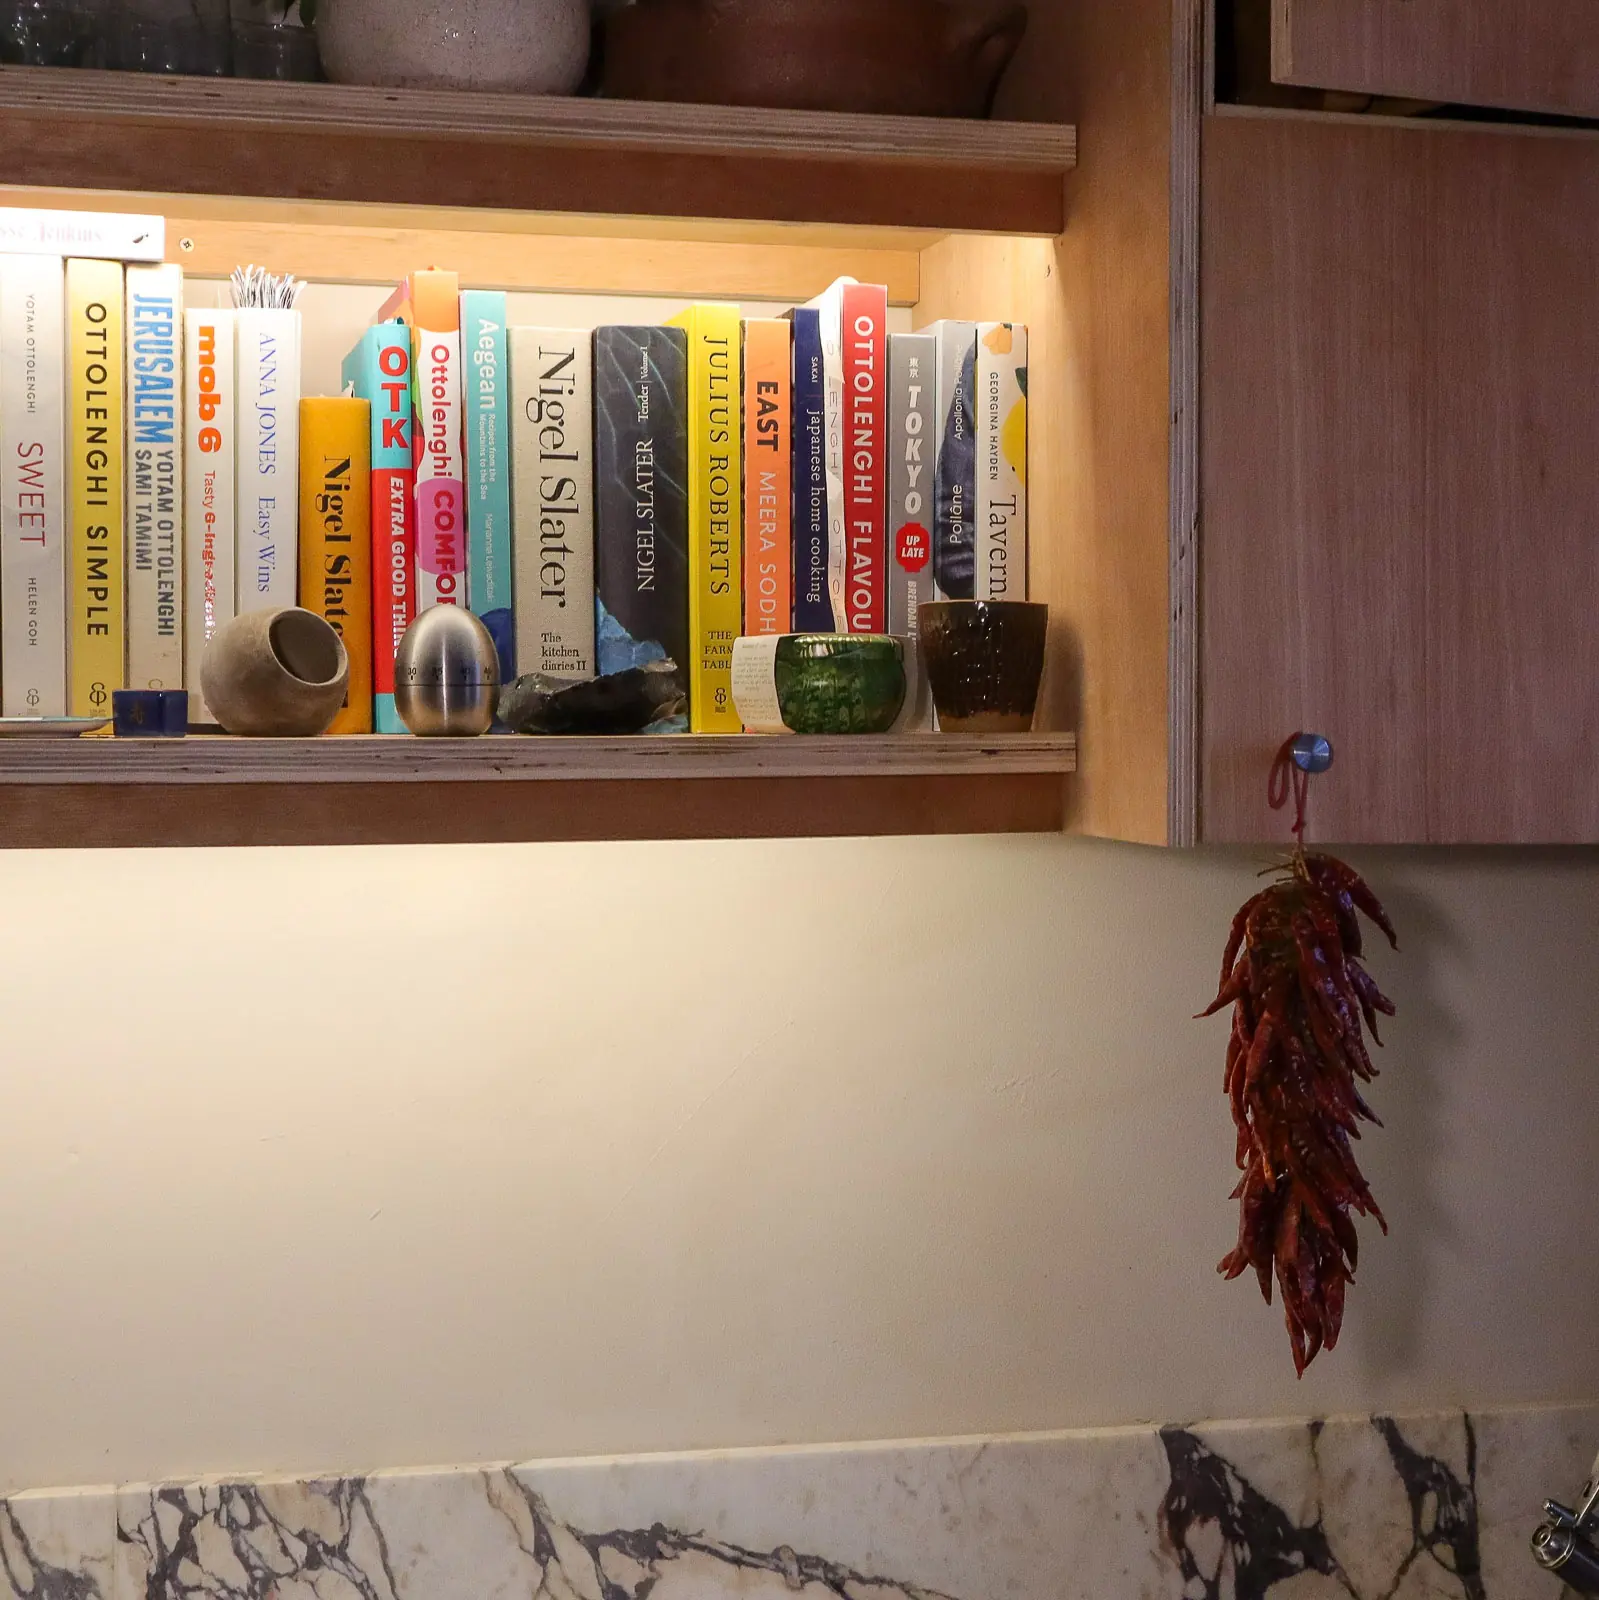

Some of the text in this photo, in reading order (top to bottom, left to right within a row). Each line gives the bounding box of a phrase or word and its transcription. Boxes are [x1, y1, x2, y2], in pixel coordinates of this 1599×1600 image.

[26, 293, 37, 414] YOTAM OTTOLENGHI
[133, 293, 174, 444] JERUSALEM
[198, 326, 222, 453] mob 6
[379, 345, 409, 449] OTK
[473, 318, 500, 410] Aegean
[640, 350, 649, 380] Volume
[811, 356, 819, 383] SAKAI
[908, 356, 919, 379] 東京
[428, 344, 453, 477] Ottolenghi
[637, 384, 649, 423] Tender
[756, 381, 779, 452] EAST
[953, 387, 963, 441] Apollonia
[989, 371, 999, 481] GEORGINA HAYDEN
[85, 302, 109, 636] OTTOLENGHI SIMPLE
[134, 449, 153, 497] SAMI
[203, 470, 216, 509] Tasty
[252, 332, 277, 593] ANNA JONES Easy Wins
[478, 413, 489, 500] Mountains to the Sea
[487, 413, 497, 482] Recipes from the
[526, 345, 580, 609] Nigel Slater
[635, 438, 654, 519] SLATER
[703, 335, 730, 596] JULIUS ROBERTS
[852, 315, 875, 630] OTTOLENGHI FLAVOU
[904, 385, 923, 515] TOKYO
[17, 442, 46, 548] SWEET
[806, 408, 826, 603] japanese home cooking
[949, 484, 963, 544] Poilâne
[157, 450, 175, 636] YOTAM OTTOLENGHI
[315, 455, 352, 637] Nigel Slat
[390, 475, 407, 658] EXTRA GOOD THIN
[433, 490, 457, 607] COMFO
[636, 523, 655, 592] NIGEL
[759, 471, 777, 633] MEERA SODH
[901, 547, 925, 558] LATE
[905, 535, 921, 546] UP
[989, 494, 1017, 600] Tavern
[28, 577, 38, 646] HELEN GOH
[541, 632, 562, 643] The
[707, 631, 732, 640] THE
[907, 580, 917, 629] BRENDAN
[541, 646, 580, 658] kitchen
[541, 659, 587, 671] diaries II
[701, 660, 732, 670] TABL
